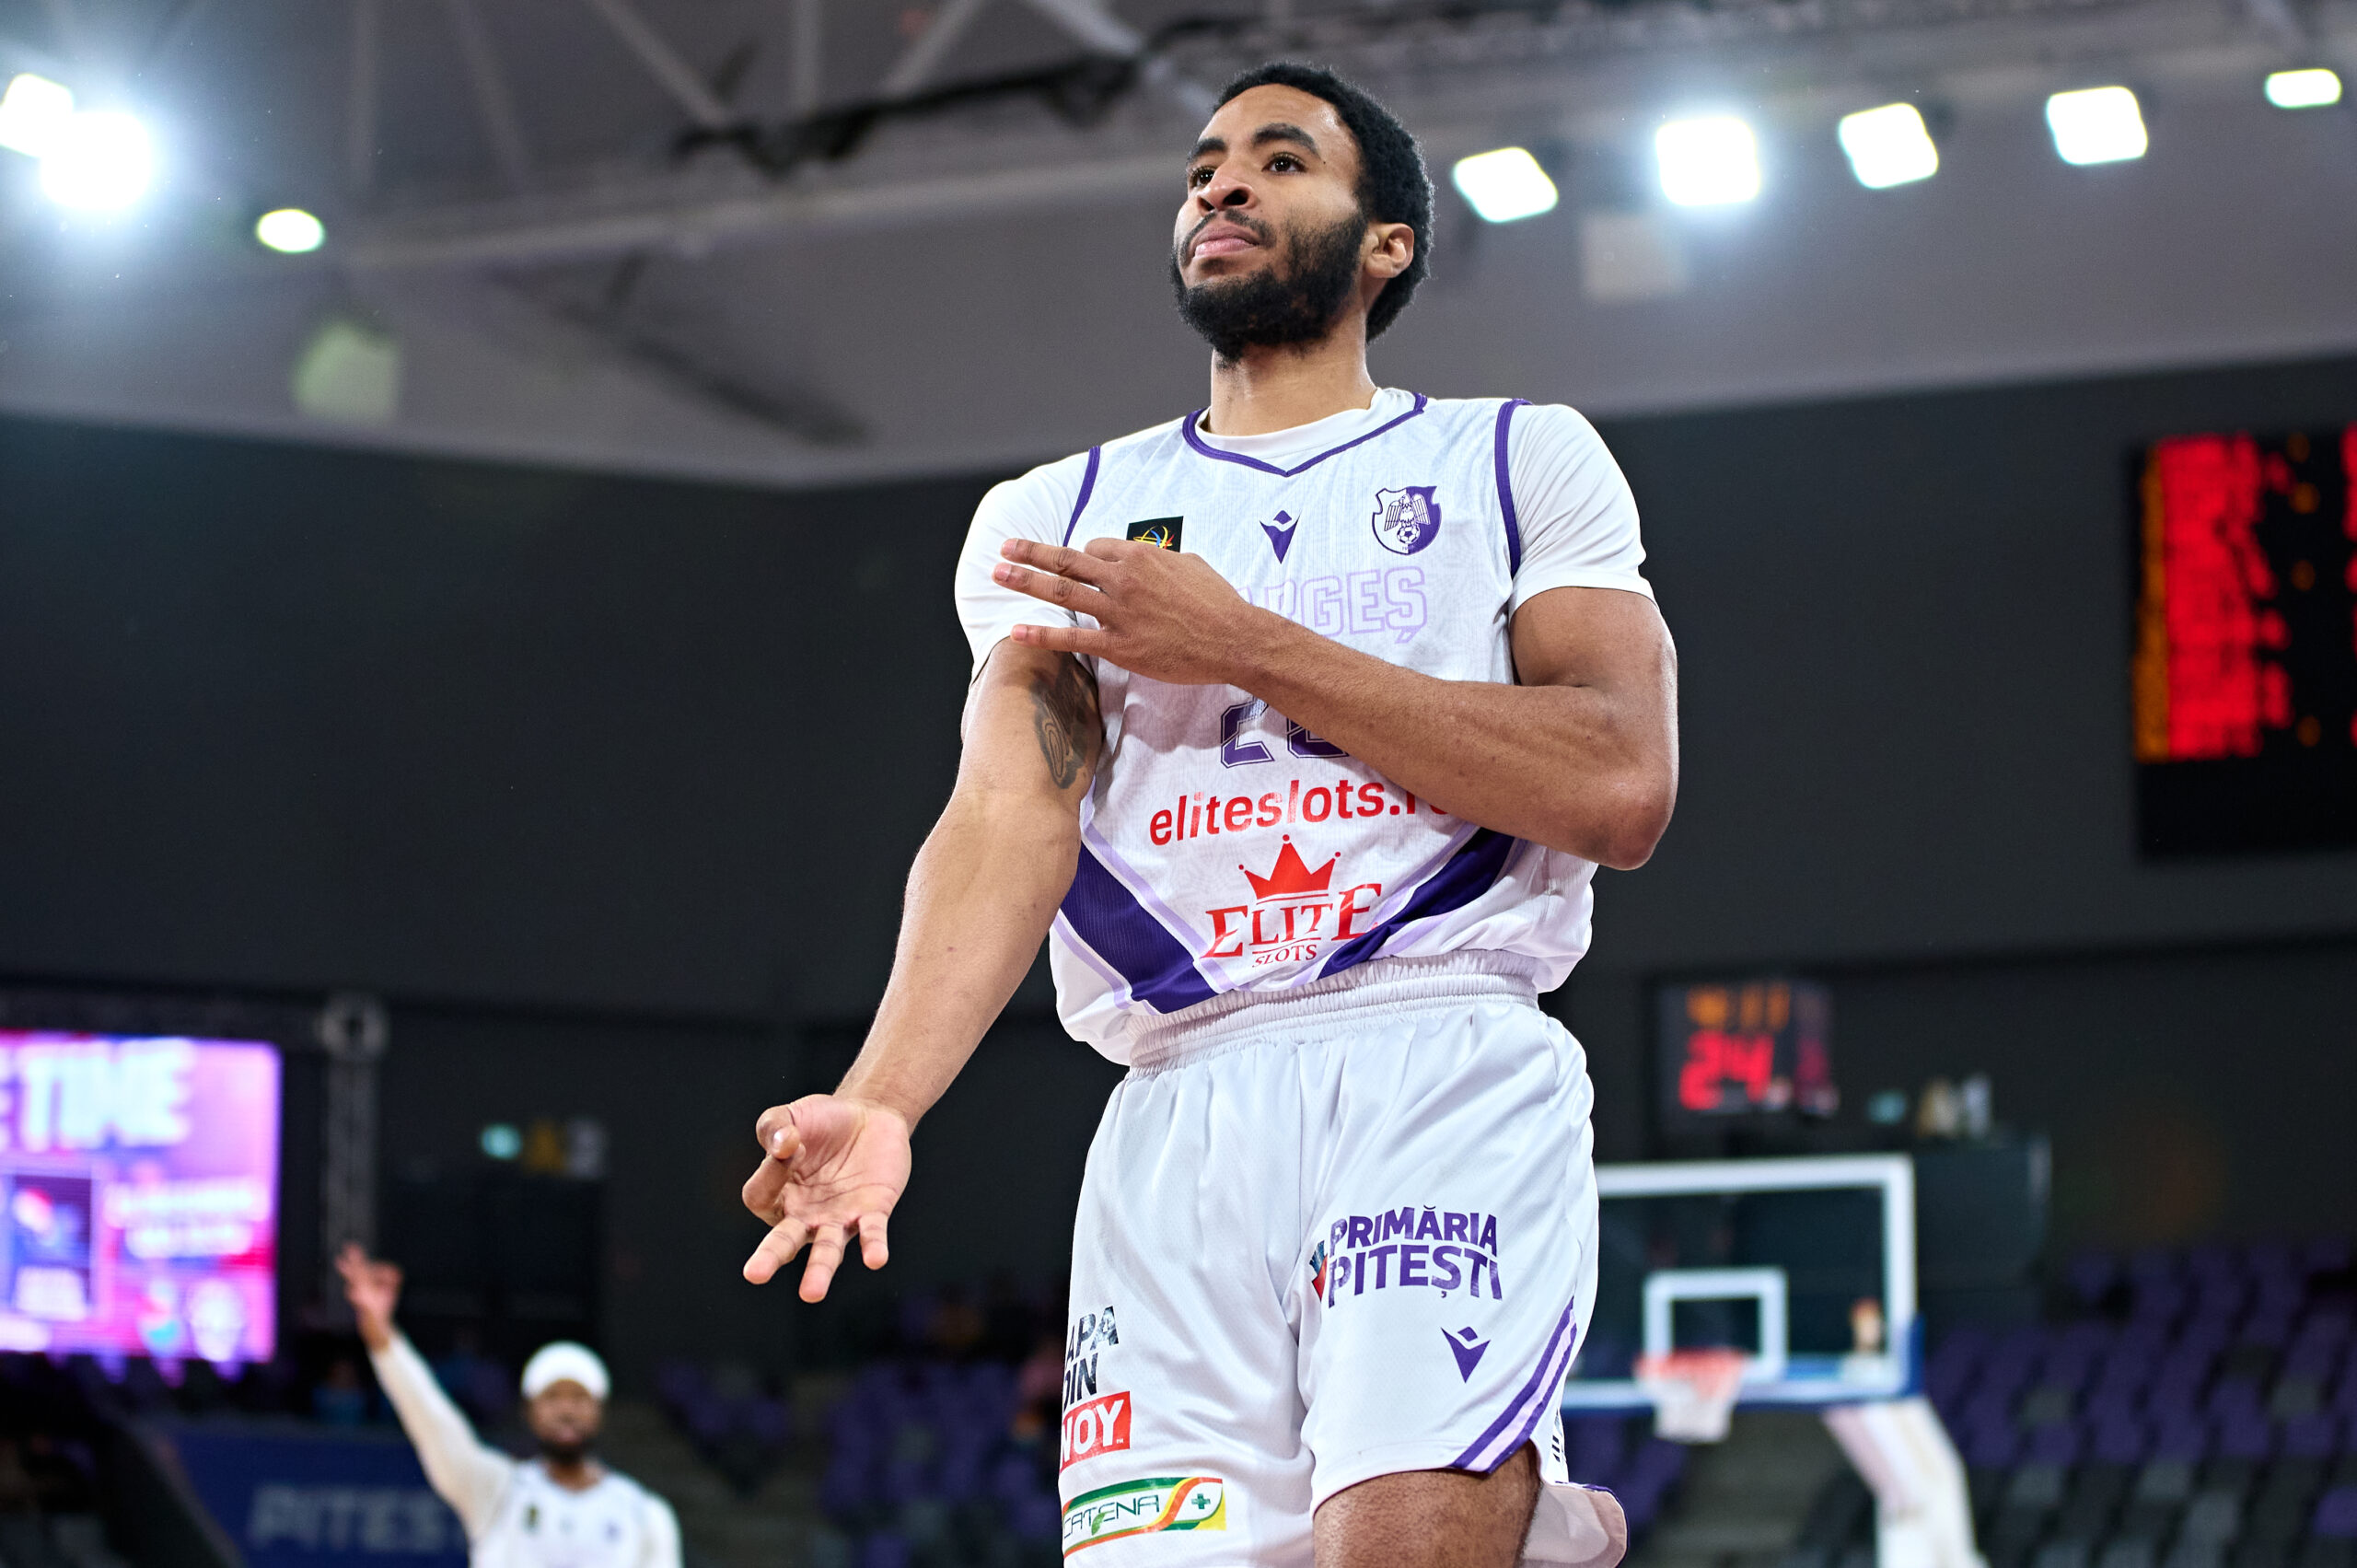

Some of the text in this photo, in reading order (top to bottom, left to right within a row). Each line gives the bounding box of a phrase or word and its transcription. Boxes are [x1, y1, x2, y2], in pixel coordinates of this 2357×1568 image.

[1150, 779, 1449, 846] eliteslots.r
[1200, 883, 1382, 959] ELITE
[1252, 944, 1318, 968] SLOTS
[1329, 1204, 1498, 1259] PRIMĂRIA
[1329, 1244, 1504, 1309] PITEȘTI
[1063, 1494, 1160, 1539] CATENA
